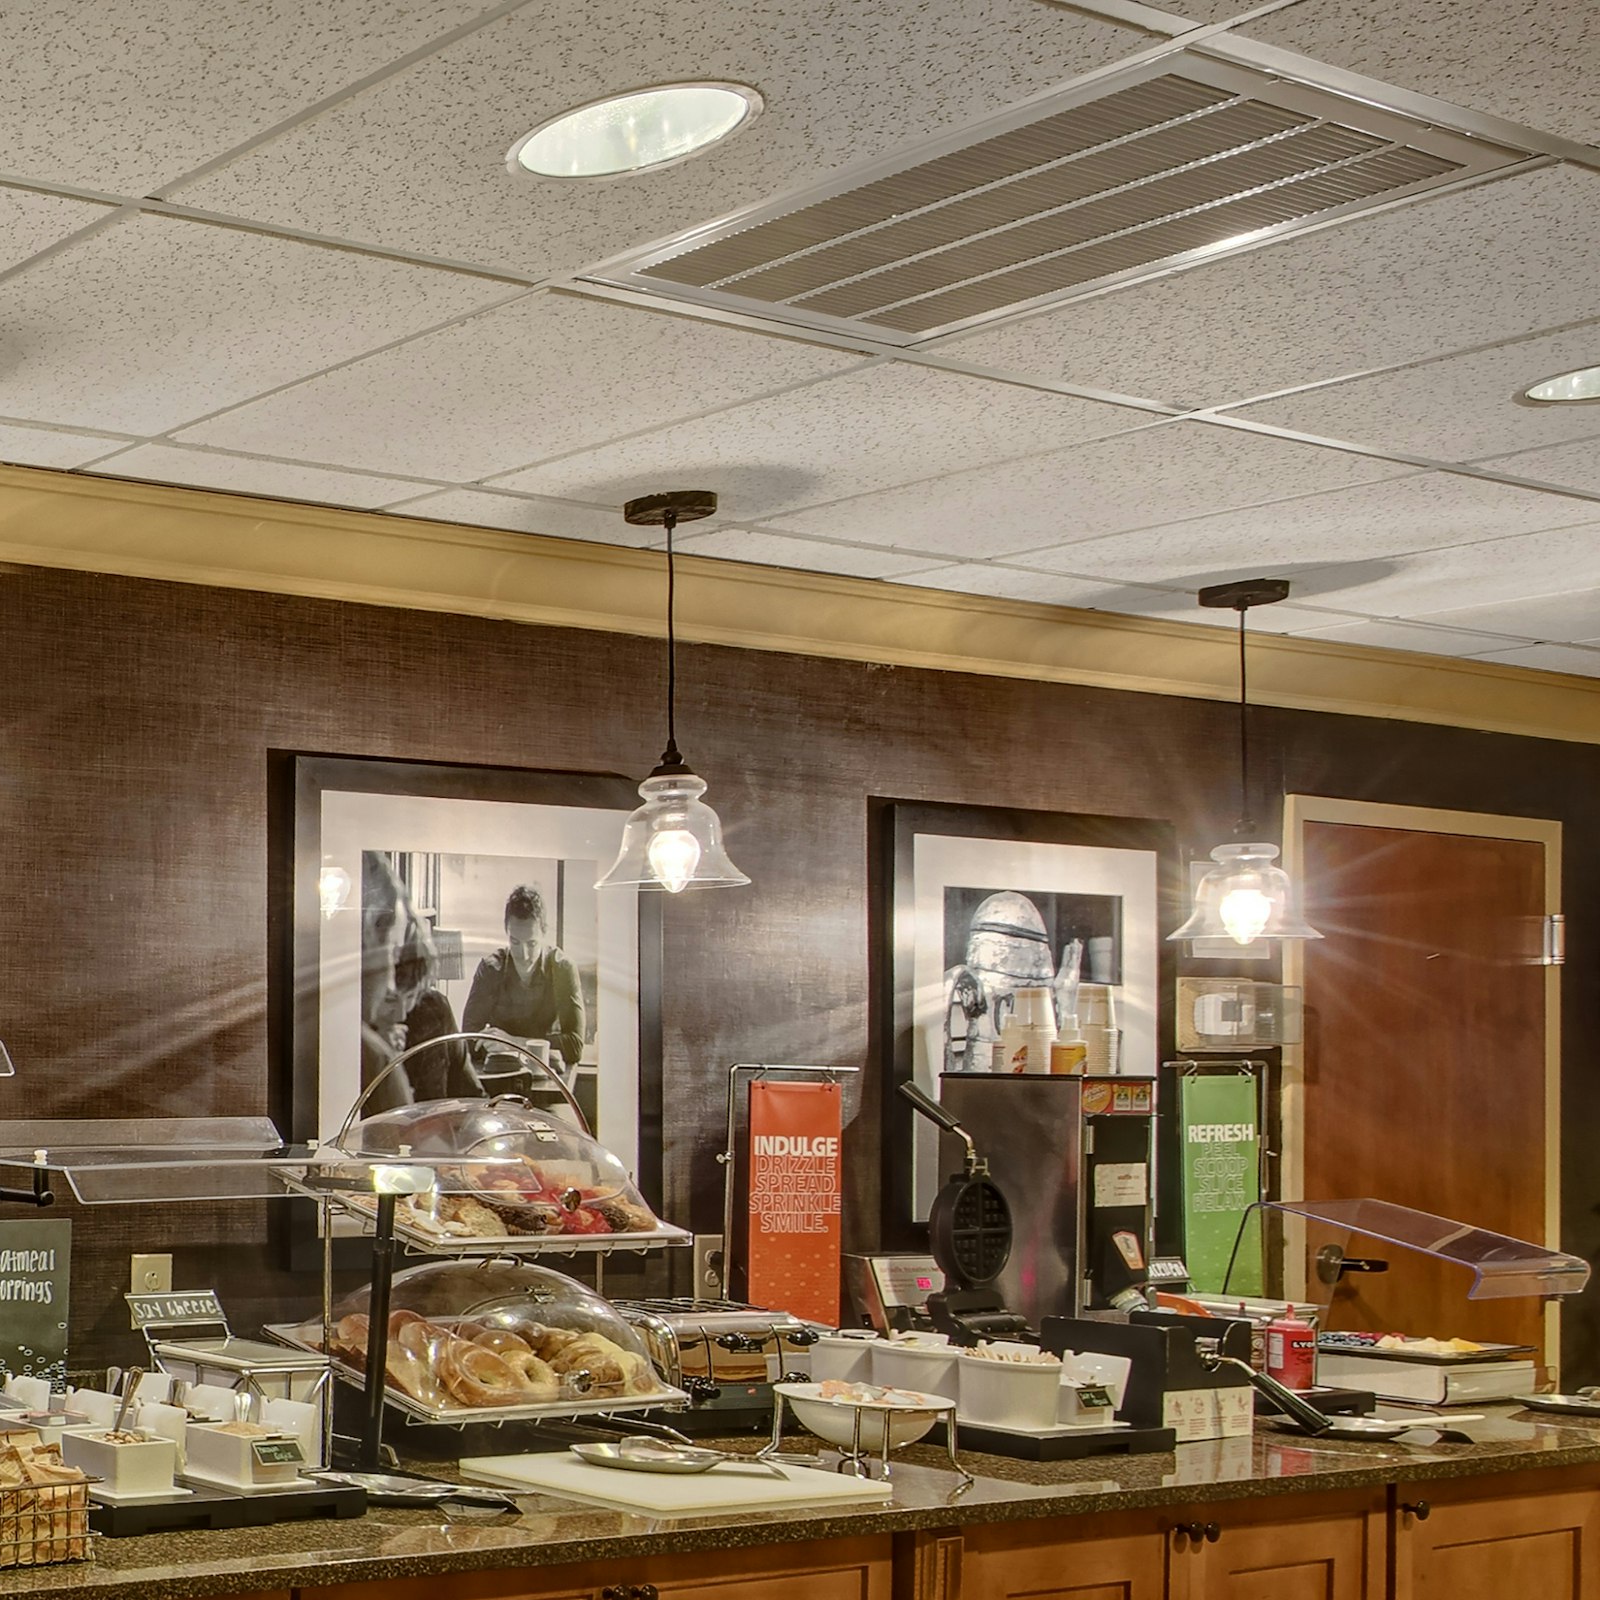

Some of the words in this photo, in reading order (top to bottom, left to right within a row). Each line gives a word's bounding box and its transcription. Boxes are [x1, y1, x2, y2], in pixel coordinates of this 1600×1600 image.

[1188, 1123, 1254, 1143] REFRESH
[754, 1135, 838, 1157] INDULGE
[755, 1155, 836, 1176] DRIZZLE
[1193, 1157, 1249, 1178] SCOOP
[755, 1174, 836, 1194] SPREAD
[1199, 1174, 1244, 1194] SLICE
[749, 1192, 841, 1214] SPRINKLE
[760, 1212, 829, 1233] SMILE.
